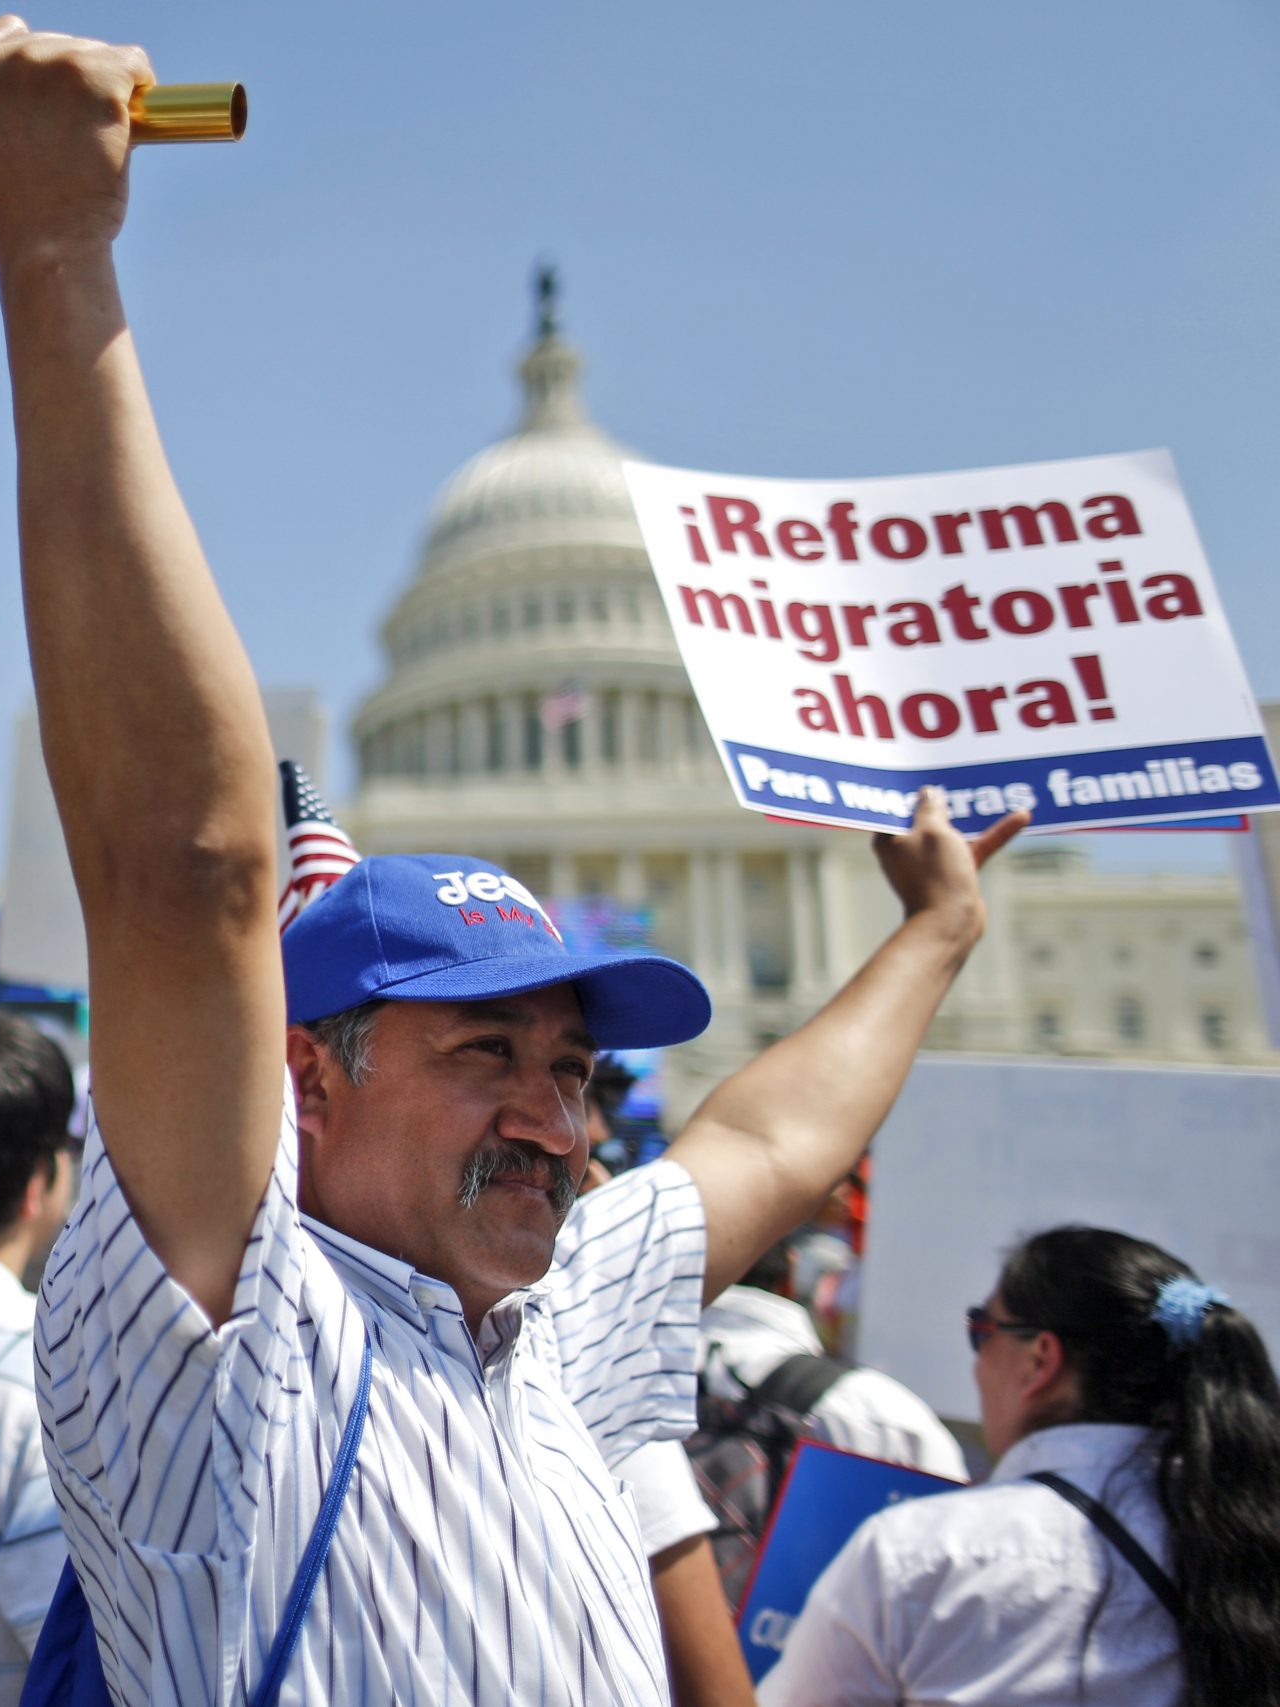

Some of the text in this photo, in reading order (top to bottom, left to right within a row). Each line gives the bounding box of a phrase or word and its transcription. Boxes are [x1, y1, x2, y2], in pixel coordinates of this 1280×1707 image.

[679, 494, 1141, 564] ¡Reforma
[678, 561, 1203, 662] migratoria
[792, 655, 1116, 739] ahora!
[737, 753, 834, 805] Para
[1047, 757, 1263, 807] familias
